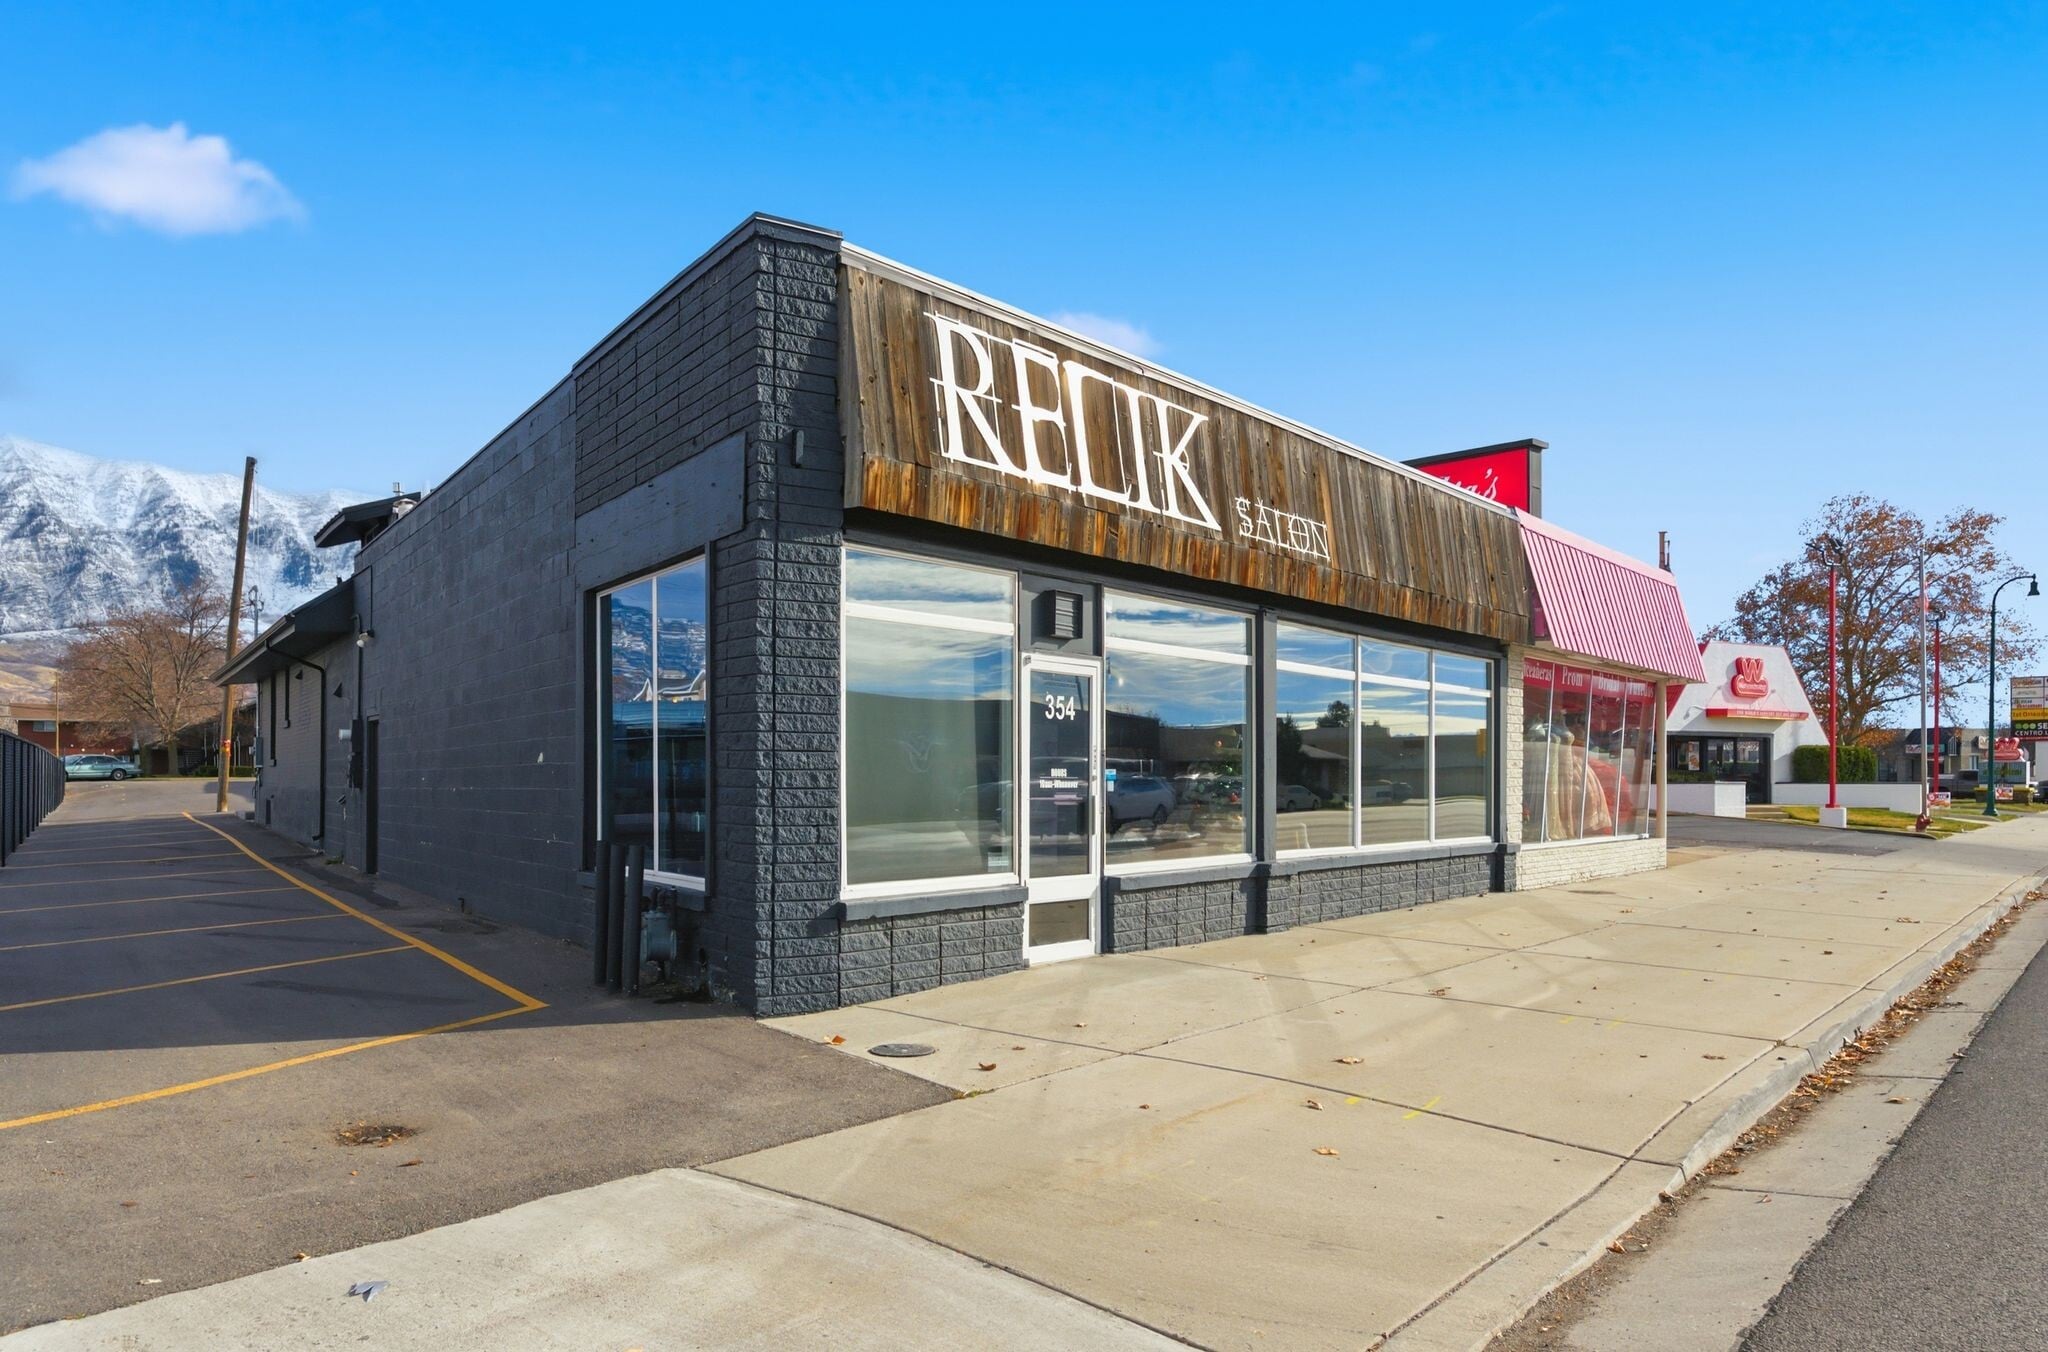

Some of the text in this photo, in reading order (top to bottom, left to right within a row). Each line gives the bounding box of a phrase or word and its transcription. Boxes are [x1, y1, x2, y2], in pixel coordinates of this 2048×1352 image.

[923, 311, 1222, 531] RELIK
[1235, 496, 1331, 561] SALON
[1562, 666, 1583, 687] Prom
[1045, 694, 1076, 721] 354
